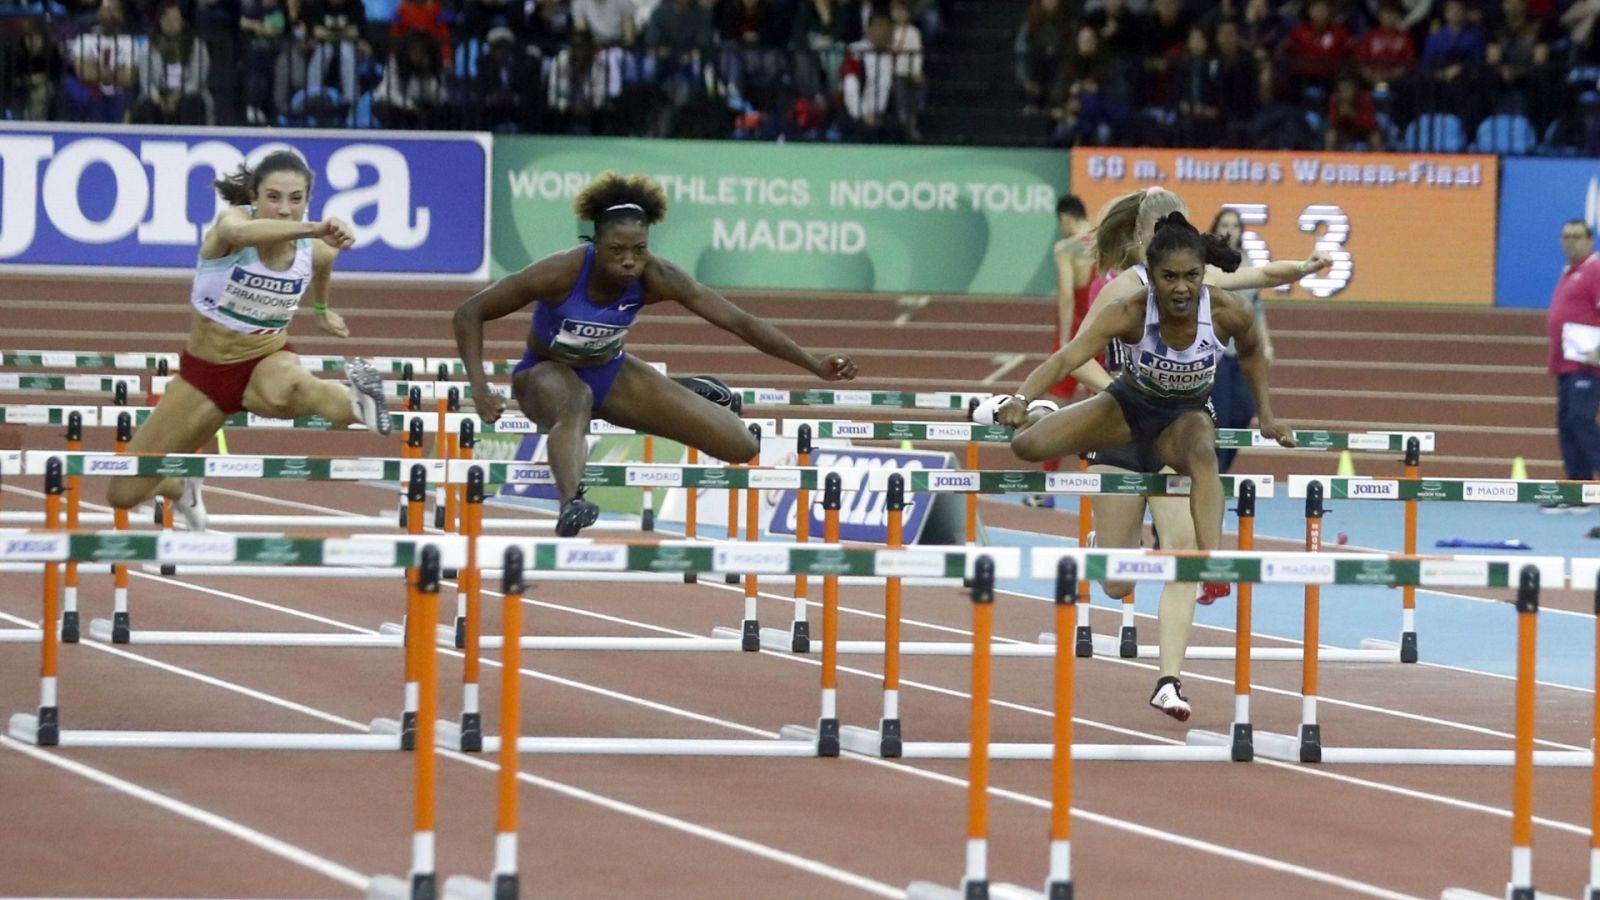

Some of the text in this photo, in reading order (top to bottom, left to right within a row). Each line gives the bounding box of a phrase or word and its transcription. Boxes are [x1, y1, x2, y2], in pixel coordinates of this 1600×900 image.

[1088, 155, 1481, 186] 60 m. Hurdles Women-Final
[508, 171, 1056, 213] WOR THLETICS INDOOR TOUR
[712, 218, 866, 254] MADRID
[938, 428, 970, 437] MADRID
[640, 472, 680, 481] MADRID
[1060, 478, 1098, 487] MADRID
[1478, 487, 1515, 496] MADRID
